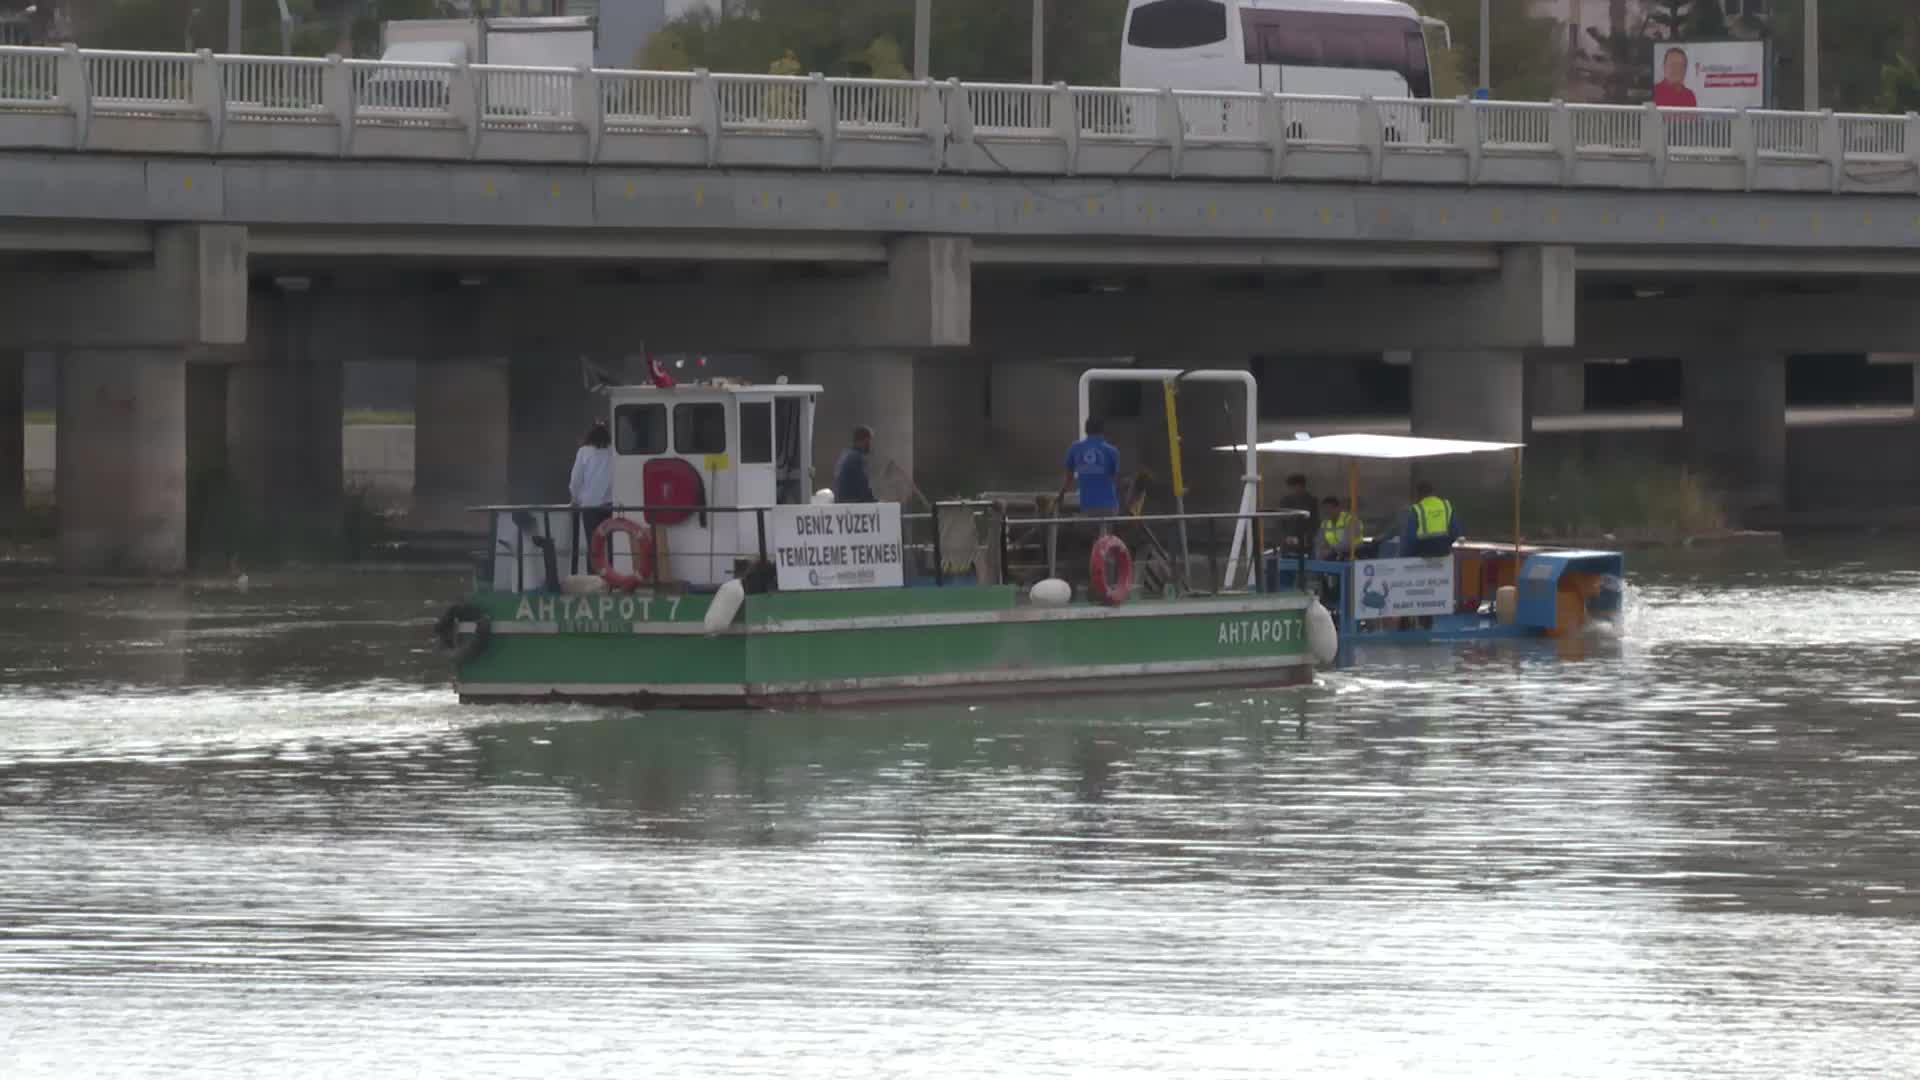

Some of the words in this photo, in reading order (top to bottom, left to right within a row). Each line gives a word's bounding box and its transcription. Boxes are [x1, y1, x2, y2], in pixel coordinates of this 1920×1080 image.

[796, 509, 833, 535] DENİZ
[837, 508, 880, 534] YÜZEYİ
[778, 542, 847, 567] TEMİZLEME
[852, 540, 901, 565] TEKNESİ
[516, 596, 654, 621] AHTAPOT
[667, 597, 681, 621] 7
[1219, 621, 1292, 643] AHTAPOT
